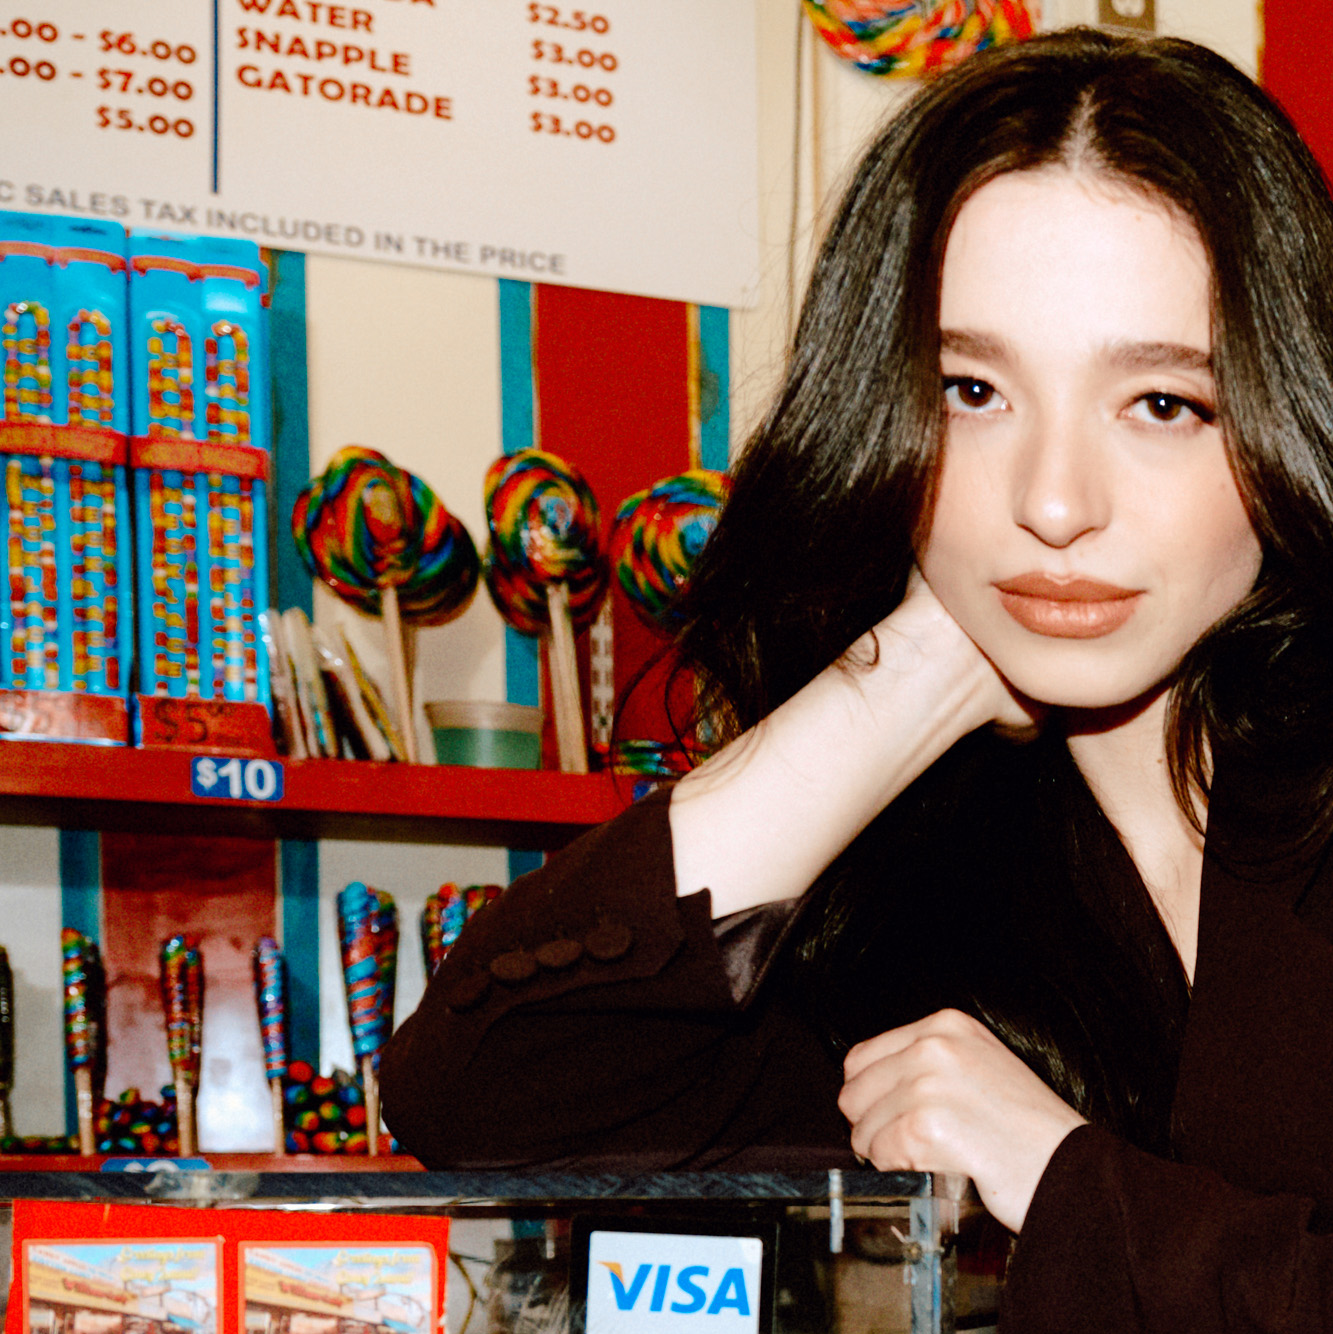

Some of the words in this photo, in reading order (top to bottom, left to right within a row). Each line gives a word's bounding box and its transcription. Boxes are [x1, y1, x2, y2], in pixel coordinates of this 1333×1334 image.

[234, 0, 374, 33] WATER
[527, 2, 609, 34] $2.50
[99, 30, 196, 64] $6.00
[236, 26, 411, 77] SNAPPLE
[532, 38, 618, 72] $3.00
[97, 67, 193, 101] $7.00
[236, 64, 454, 121] GATORADE
[527, 74, 613, 107] $3.00
[96, 105, 194, 138] $5.00
[530, 111, 616, 143] $3.00
[25, 183, 131, 218] SALES
[138, 198, 198, 225] TAX
[205, 208, 364, 248] INCLUDED
[374, 232, 403, 253] IN
[412, 236, 472, 263] THE
[479, 245, 567, 275] PRICE
[196, 758, 277, 800] $10
[598, 1261, 751, 1317] VISA
